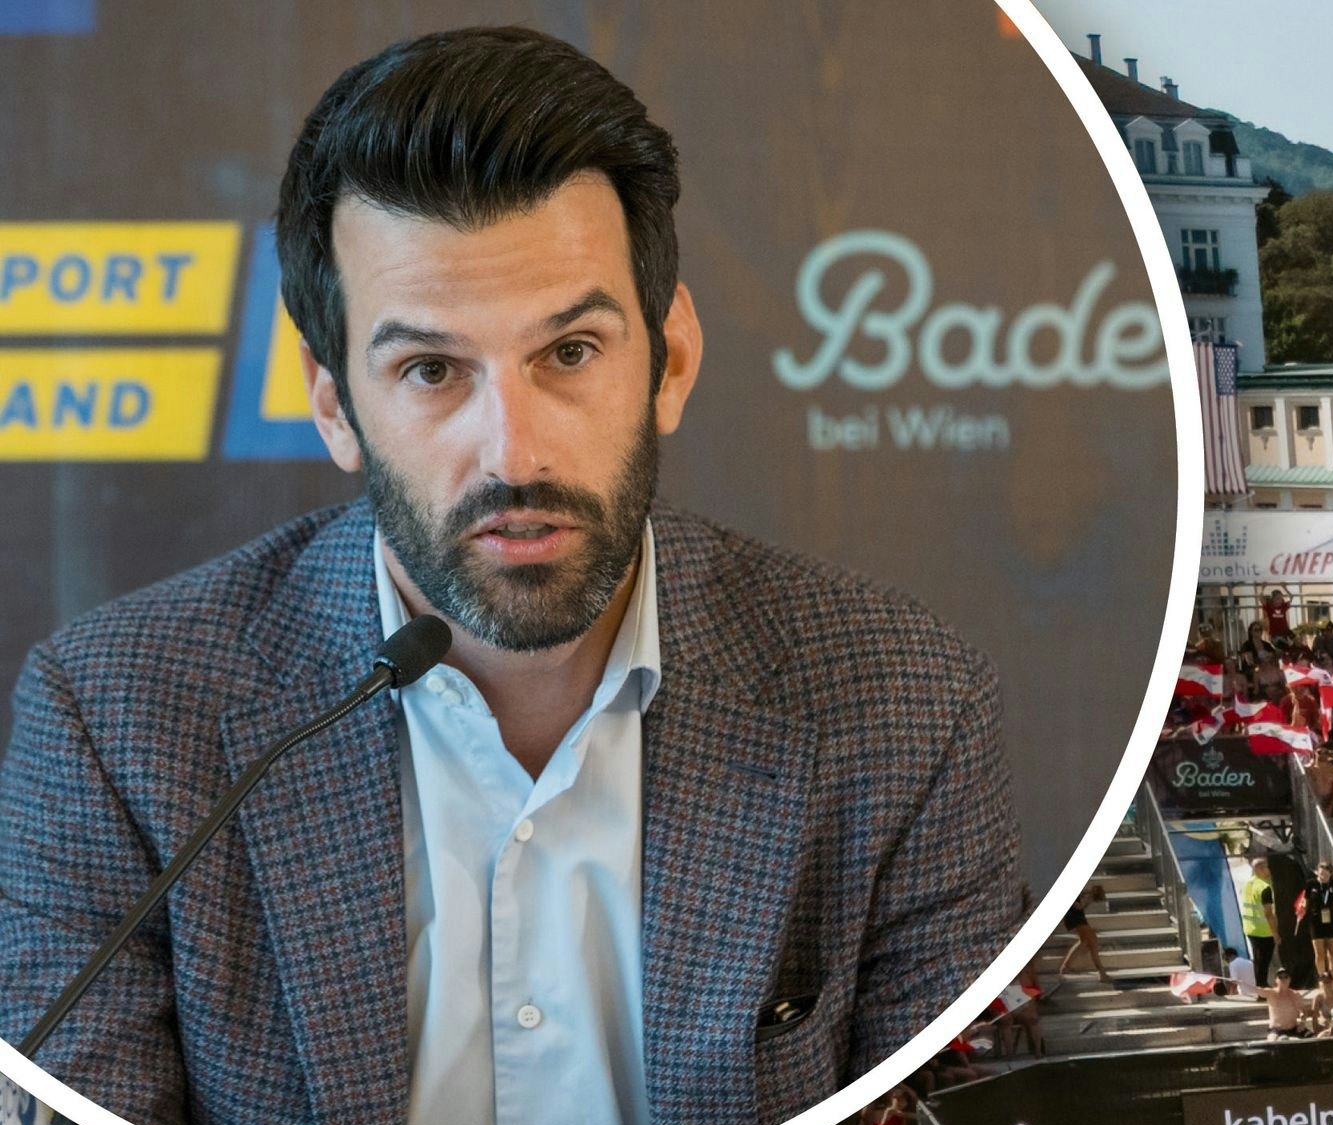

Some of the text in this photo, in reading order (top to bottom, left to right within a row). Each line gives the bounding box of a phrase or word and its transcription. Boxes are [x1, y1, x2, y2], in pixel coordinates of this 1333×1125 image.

[806, 405, 1010, 450] bei Wien
[1172, 761, 1256, 787] Baden
